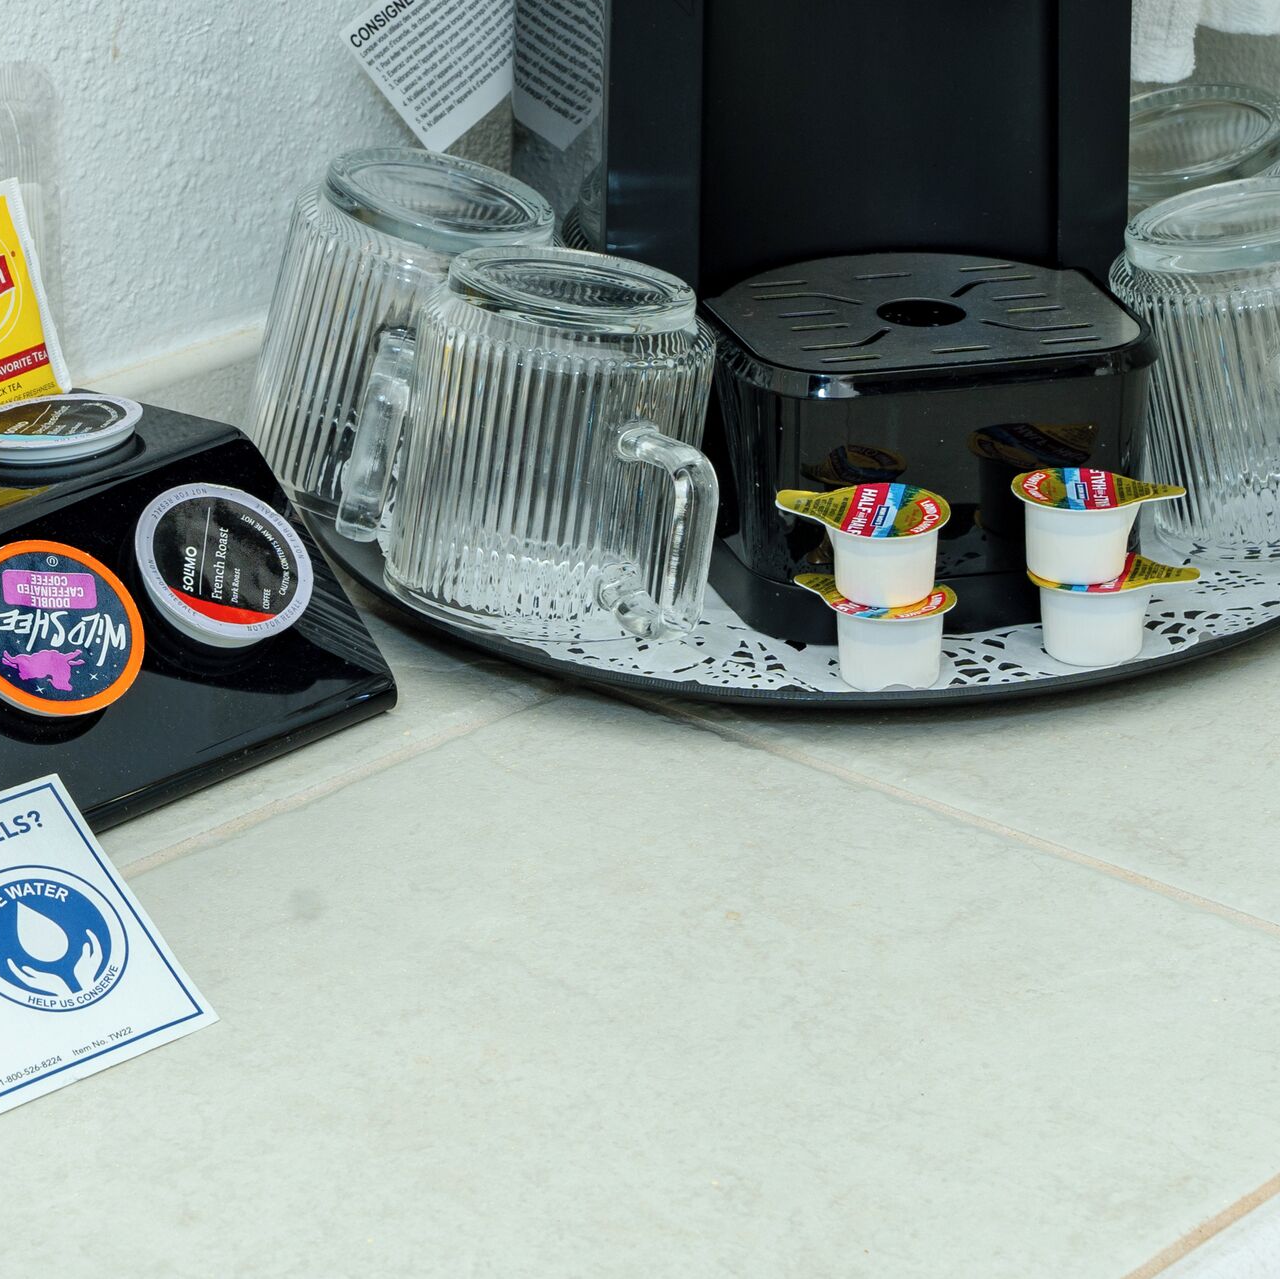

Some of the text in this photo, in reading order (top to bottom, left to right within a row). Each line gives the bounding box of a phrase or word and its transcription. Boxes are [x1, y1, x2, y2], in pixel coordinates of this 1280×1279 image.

[7, 382, 23, 396] TEA
[175, 490, 190, 500] FOR
[857, 488, 879, 513] HALF
[151, 496, 175, 520] RESALE
[240, 514, 256, 526] HOT
[254, 521, 265, 531] BE
[261, 527, 275, 542] MAY
[211, 527, 230, 600] French Roast
[270, 540, 290, 570] CONTENTS
[16, 583, 84, 598] CAFFEINATED
[31, 573, 68, 587] COFFEE
[231, 567, 241, 604] Dark Roast
[31, 595, 71, 609] DOUBLE
[262, 588, 271, 610] COFFEE
[4, 882, 69, 903] WATER
[27, 964, 119, 1008] HELP US CONSERVE
[71, 1026, 134, 1057] Item No. TW22
